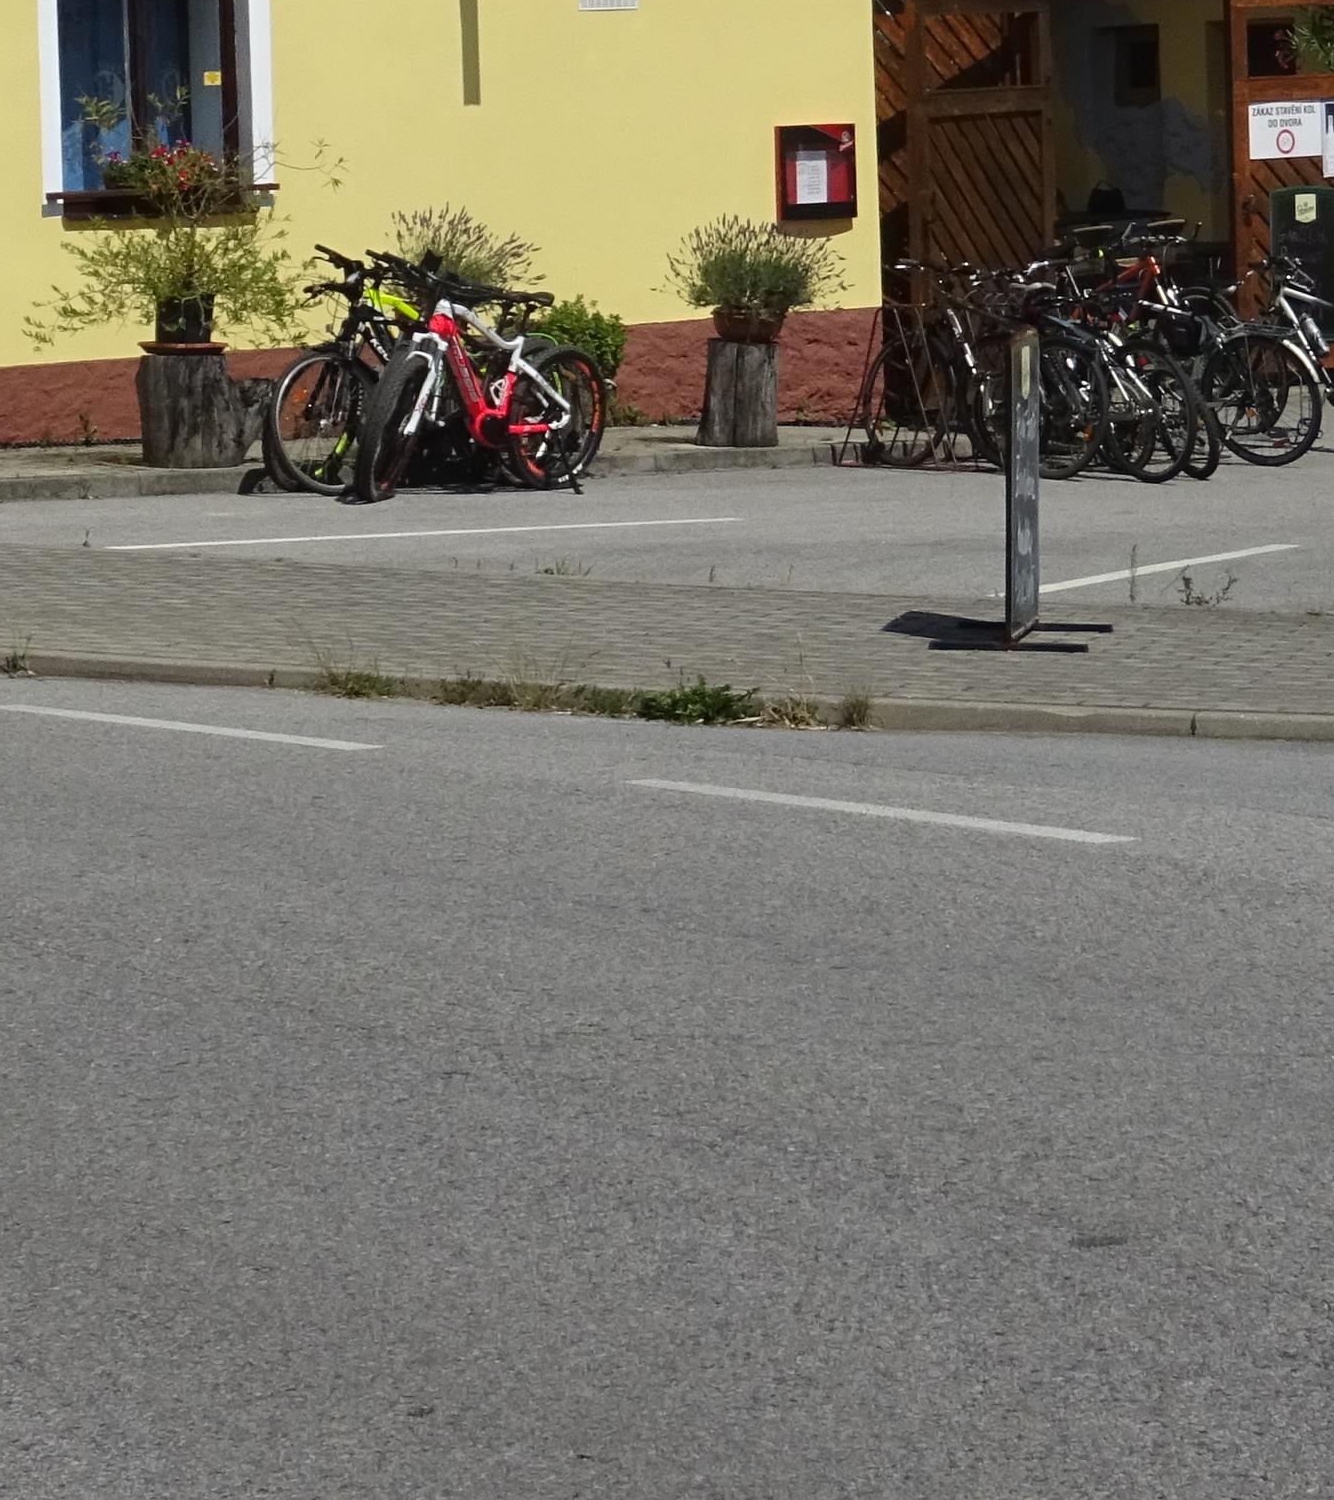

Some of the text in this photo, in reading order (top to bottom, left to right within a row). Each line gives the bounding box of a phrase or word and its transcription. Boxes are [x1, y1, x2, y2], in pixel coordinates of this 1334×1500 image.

[1252, 105, 1274, 116] ZÁKAZ
[1268, 118, 1303, 128] DO DVORA
